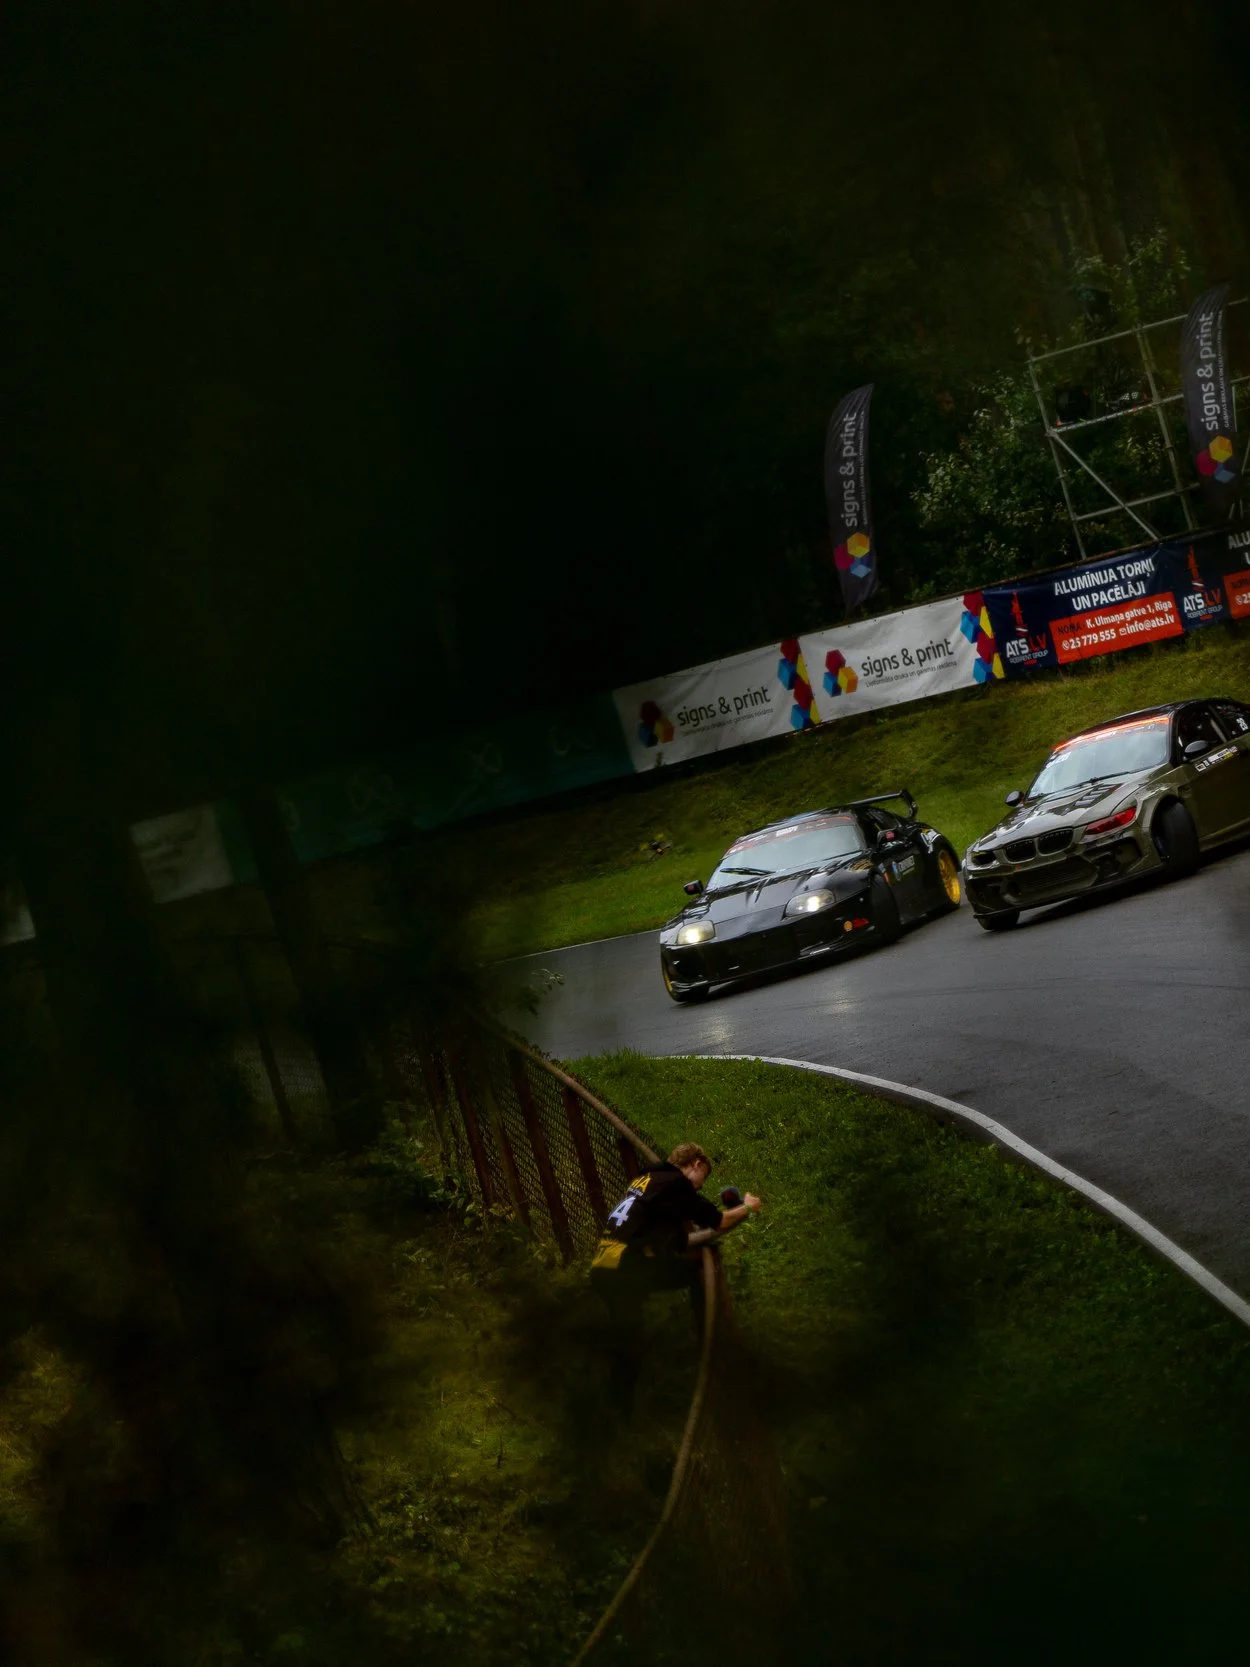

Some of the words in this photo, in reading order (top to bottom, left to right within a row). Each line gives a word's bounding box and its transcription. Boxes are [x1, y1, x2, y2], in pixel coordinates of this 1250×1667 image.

[1196, 312, 1216, 359] print
[1197, 363, 1214, 378] &
[1201, 382, 1220, 431] signs
[840, 413, 857, 458] print
[840, 462, 854, 474] &
[841, 480, 859, 527] signs
[1054, 568, 1118, 596] ALUMĪNIJA
[1072, 596, 1093, 611] UN
[1093, 581, 1146, 607] PACĒLĀJI
[1069, 638, 1081, 649] 25
[1082, 633, 1098, 646] 779
[1099, 629, 1116, 642] 555
[1126, 613, 1174, 634] info@ats.lv
[1086, 619, 1095, 628] K.
[1125, 608, 1146, 620] gatve
[1147, 605, 1154, 613] 1,
[861, 655, 899, 678] signs
[901, 648, 915, 666] &
[916, 638, 953, 666] print
[677, 703, 716, 727] signs
[718, 696, 731, 714] &
[733, 686, 770, 715] print
